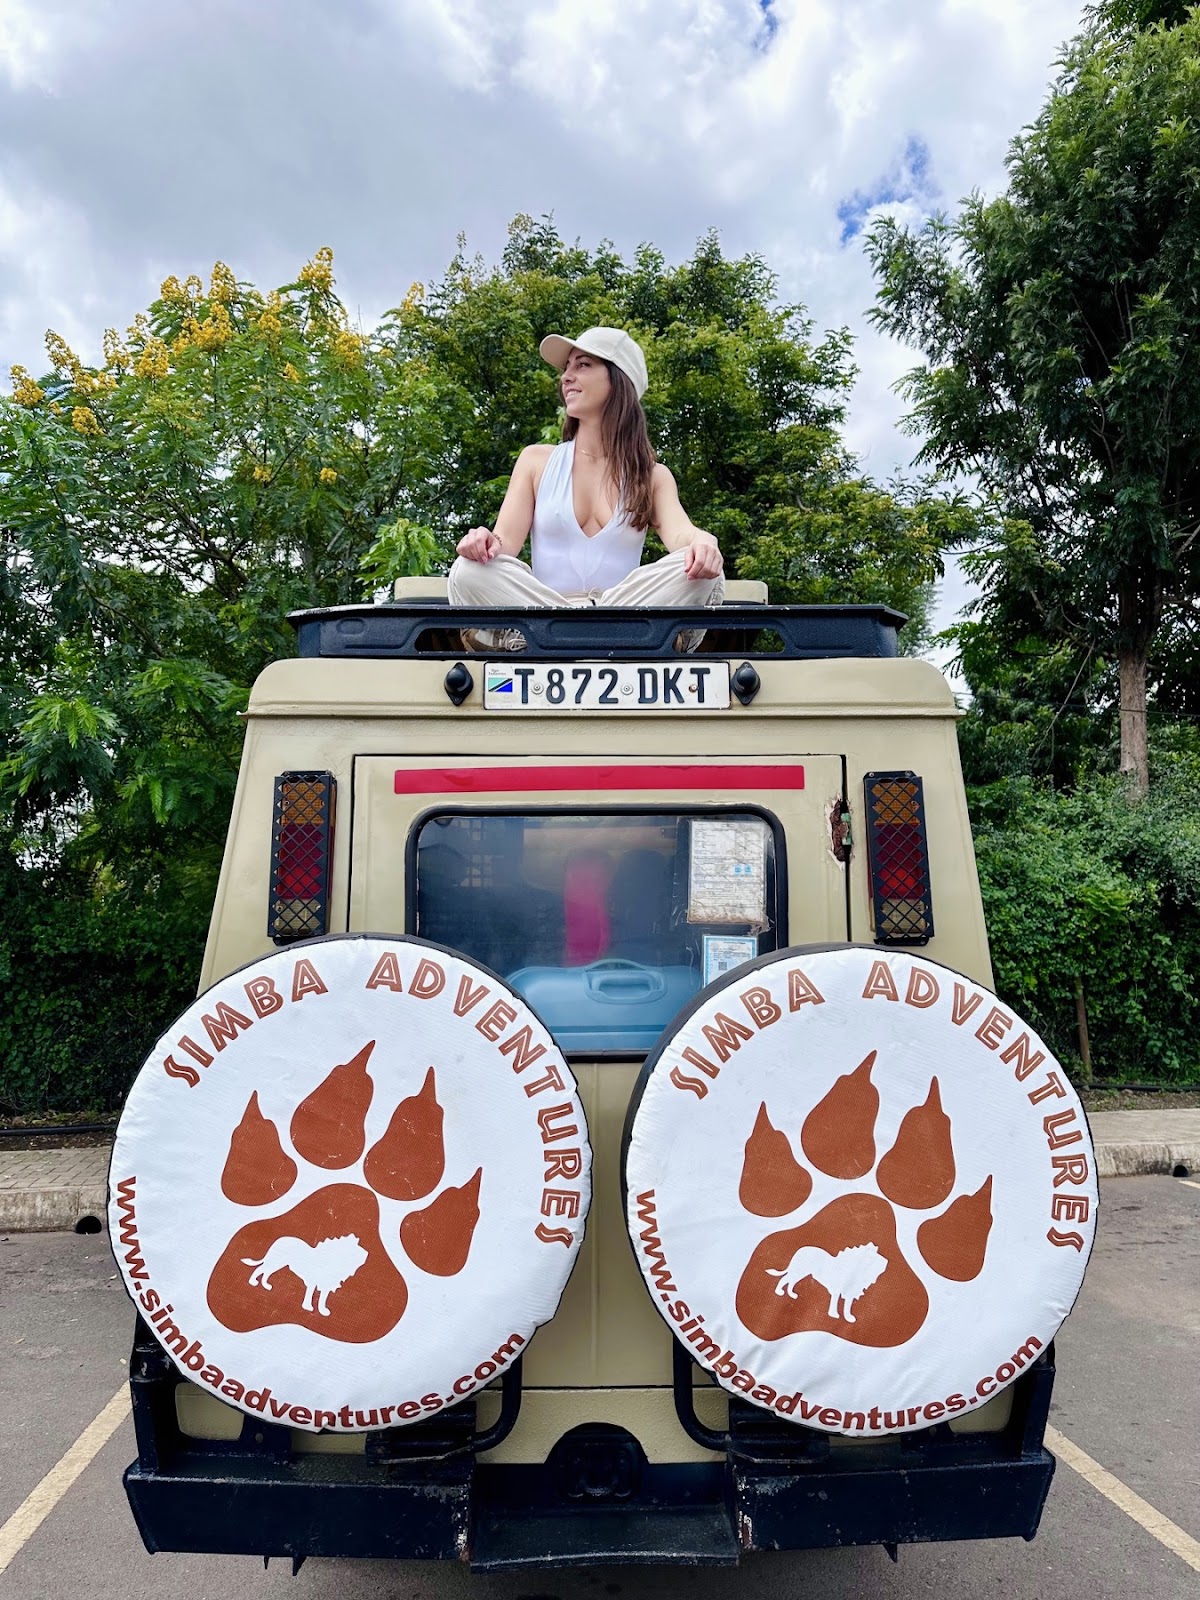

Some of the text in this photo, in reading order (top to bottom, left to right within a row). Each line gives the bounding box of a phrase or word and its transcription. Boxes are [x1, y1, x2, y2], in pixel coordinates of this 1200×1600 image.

[514, 667, 711, 704] T 872 DKT
[163, 951, 582, 1250] SIMBA ADVENTURES
[669, 959, 1090, 1253] SIMBA ADVENTURES
[117, 1175, 526, 1429] www.simbaadventures.com
[635, 1188, 1044, 1431] www.simbaadventures.com
